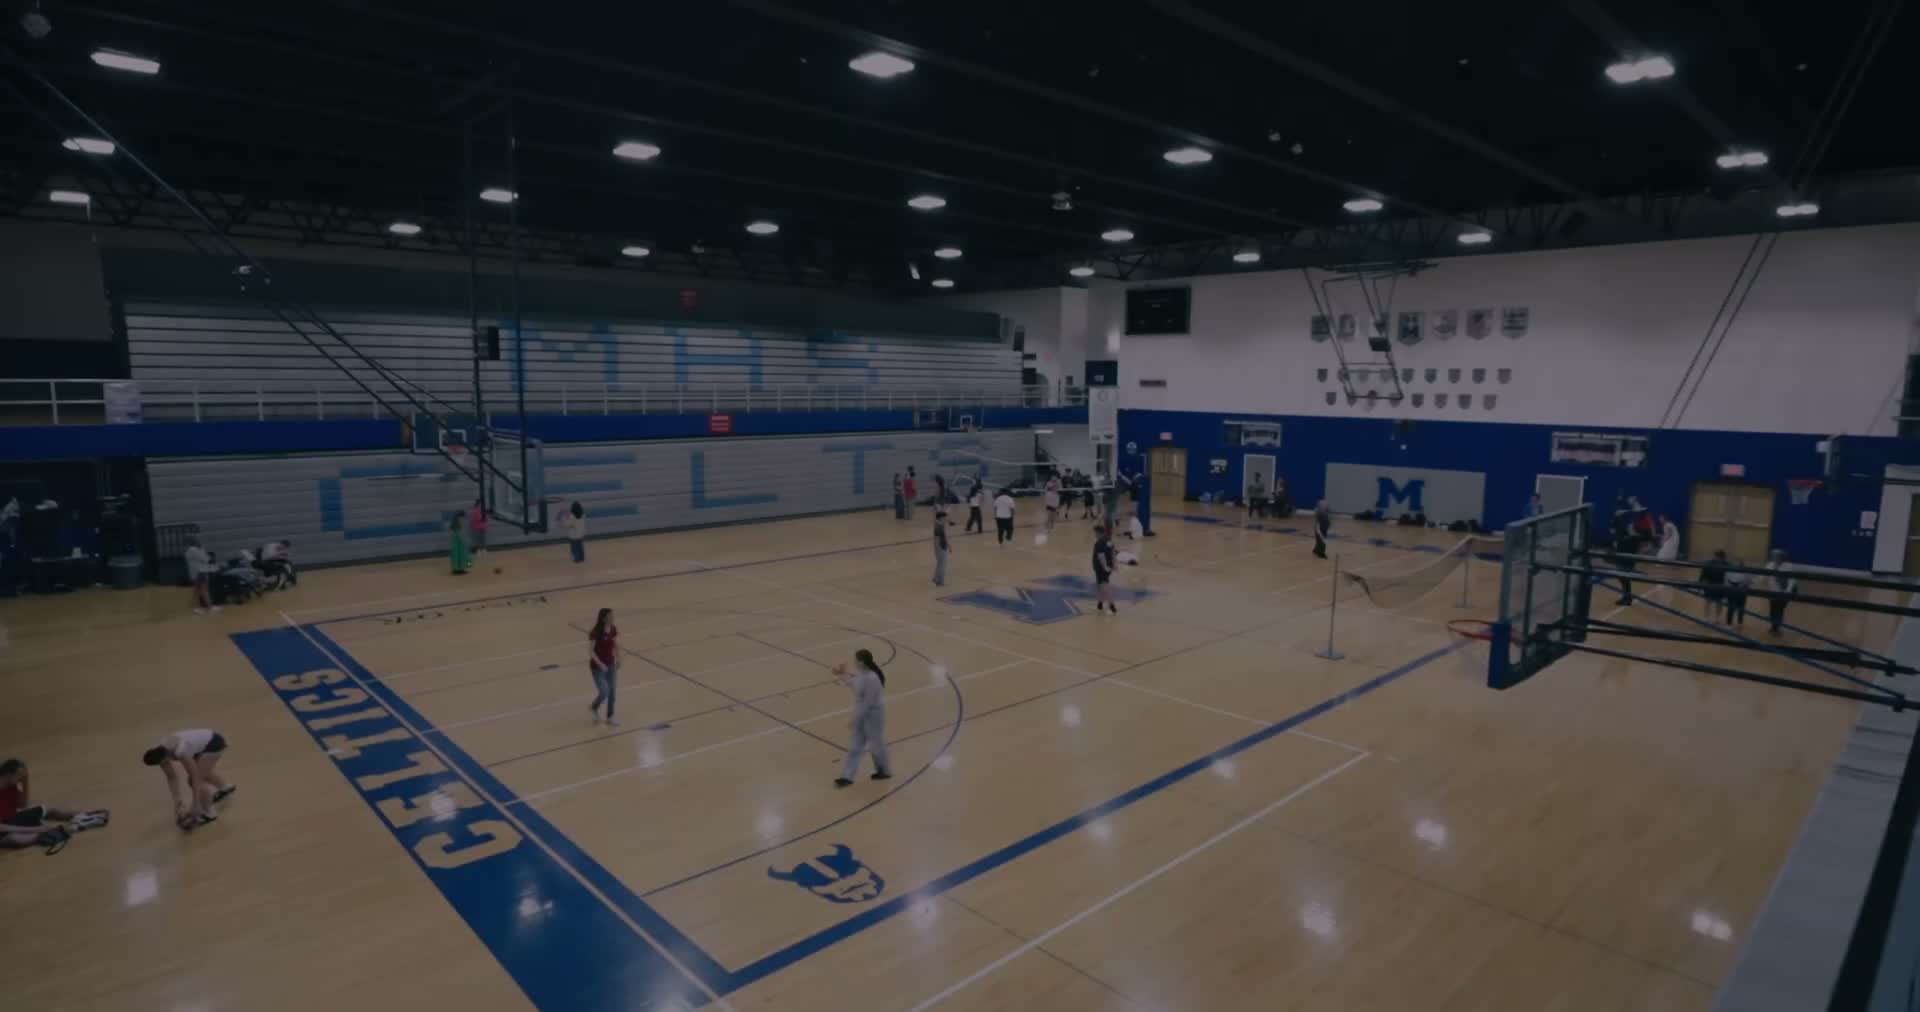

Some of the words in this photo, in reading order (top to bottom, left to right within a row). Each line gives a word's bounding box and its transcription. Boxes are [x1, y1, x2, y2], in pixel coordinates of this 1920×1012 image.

[498, 319, 881, 393] MHS
[1376, 477, 1424, 511] M
[272, 668, 523, 869] CELTICS
